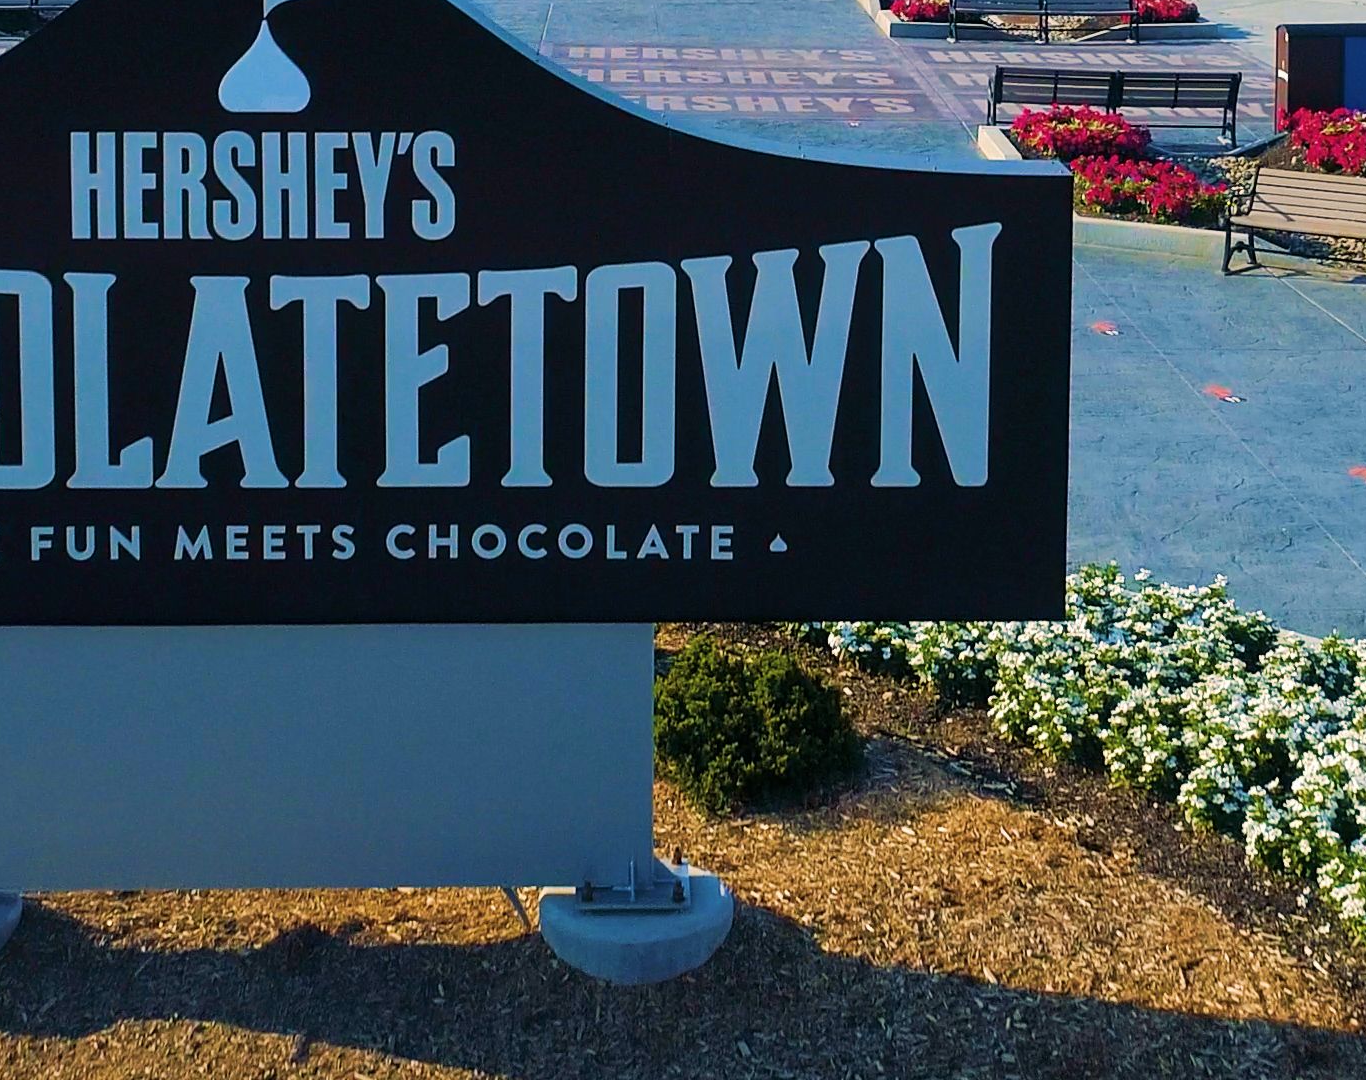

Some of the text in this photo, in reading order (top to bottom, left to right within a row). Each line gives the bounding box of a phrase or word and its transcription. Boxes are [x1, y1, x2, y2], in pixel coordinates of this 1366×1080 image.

[568, 46, 877, 62] HERSHEY'S
[620, 94, 916, 114] RSHEY'S
[70, 130, 456, 241] HERSHEY'S
[30, 525, 141, 562] FUN
[173, 524, 357, 561] MEETS
[386, 522, 735, 560] CHOCOLATE
